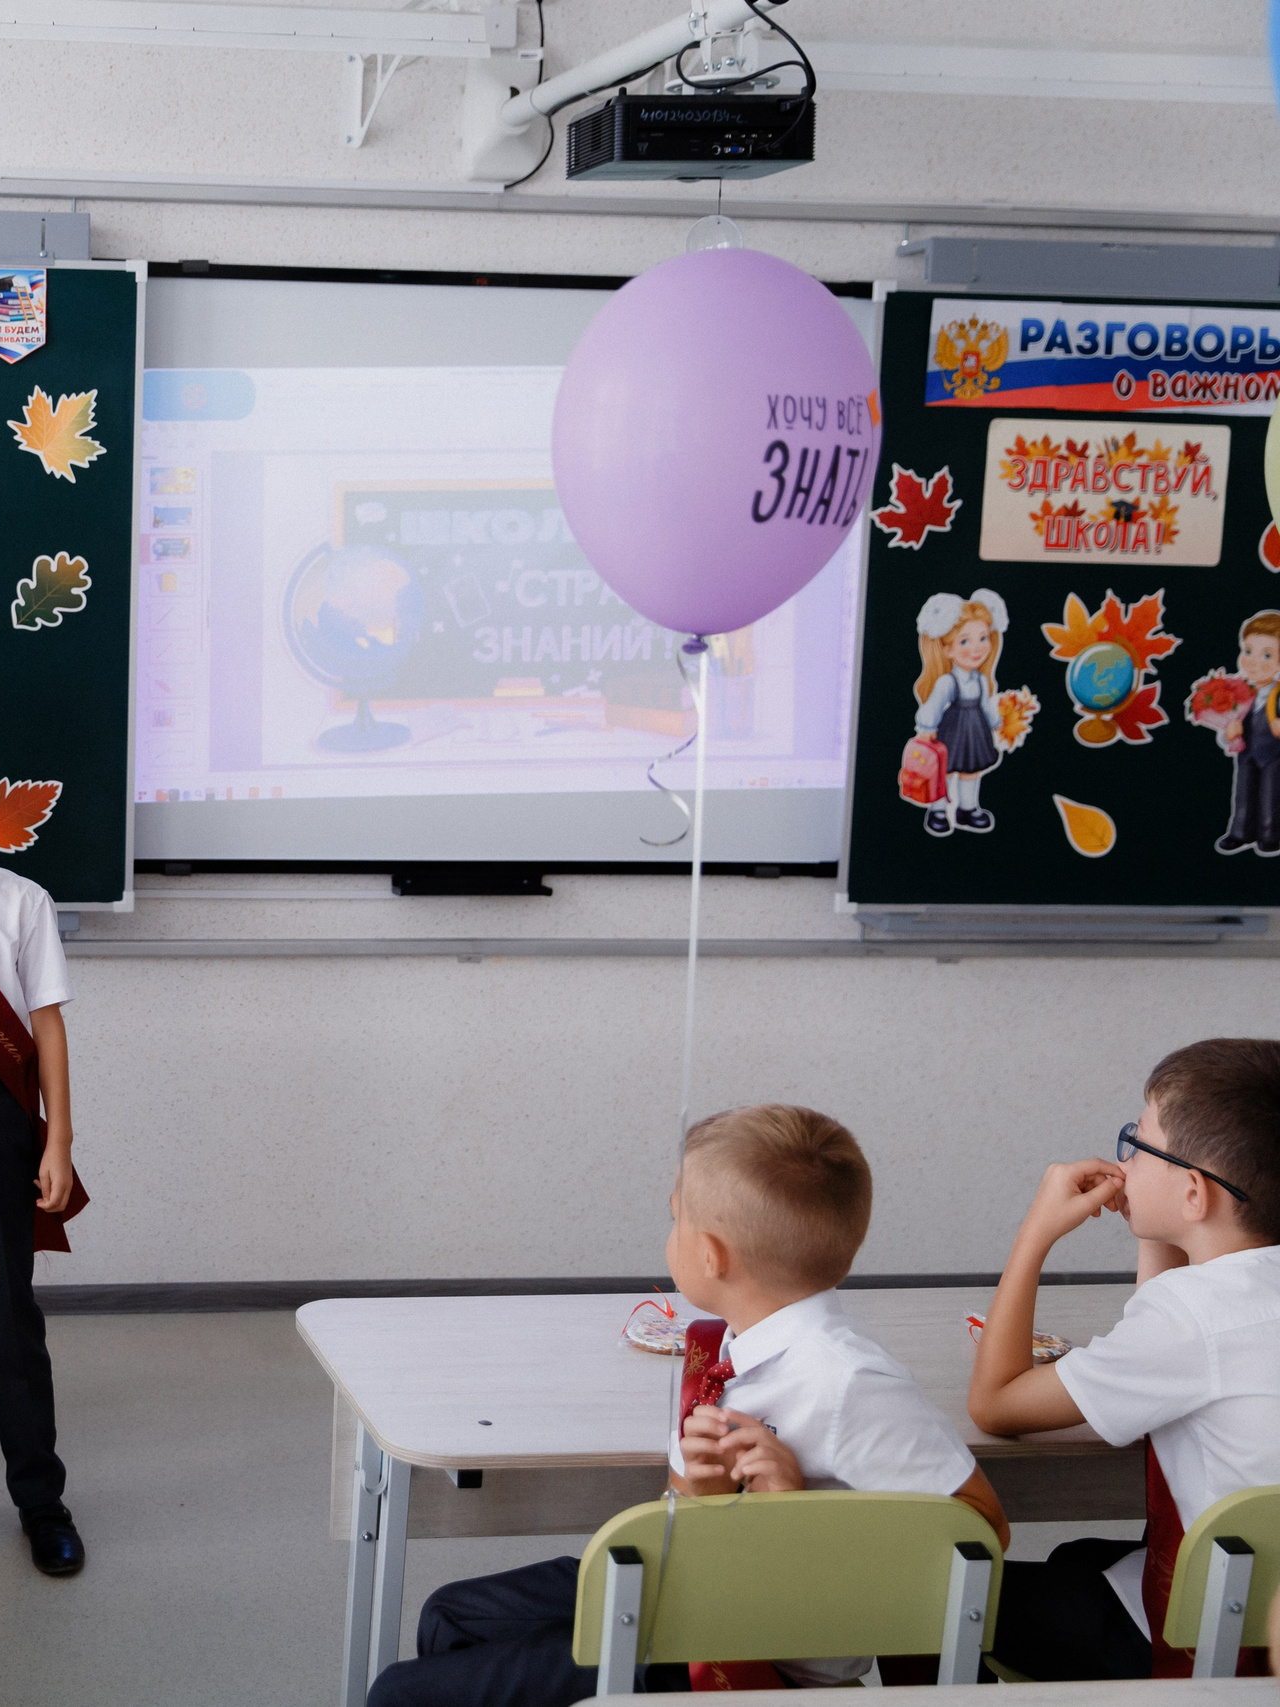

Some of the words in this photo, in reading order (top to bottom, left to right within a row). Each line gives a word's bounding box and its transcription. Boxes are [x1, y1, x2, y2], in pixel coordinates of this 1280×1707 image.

[4, 326, 40, 335] БУДЕМ
[766, 394, 827, 431] ХОЧУ
[1006, 453, 1219, 501] ЗДРАВСТВУЙ,
[1043, 515, 1166, 554] ШКОЛА!
